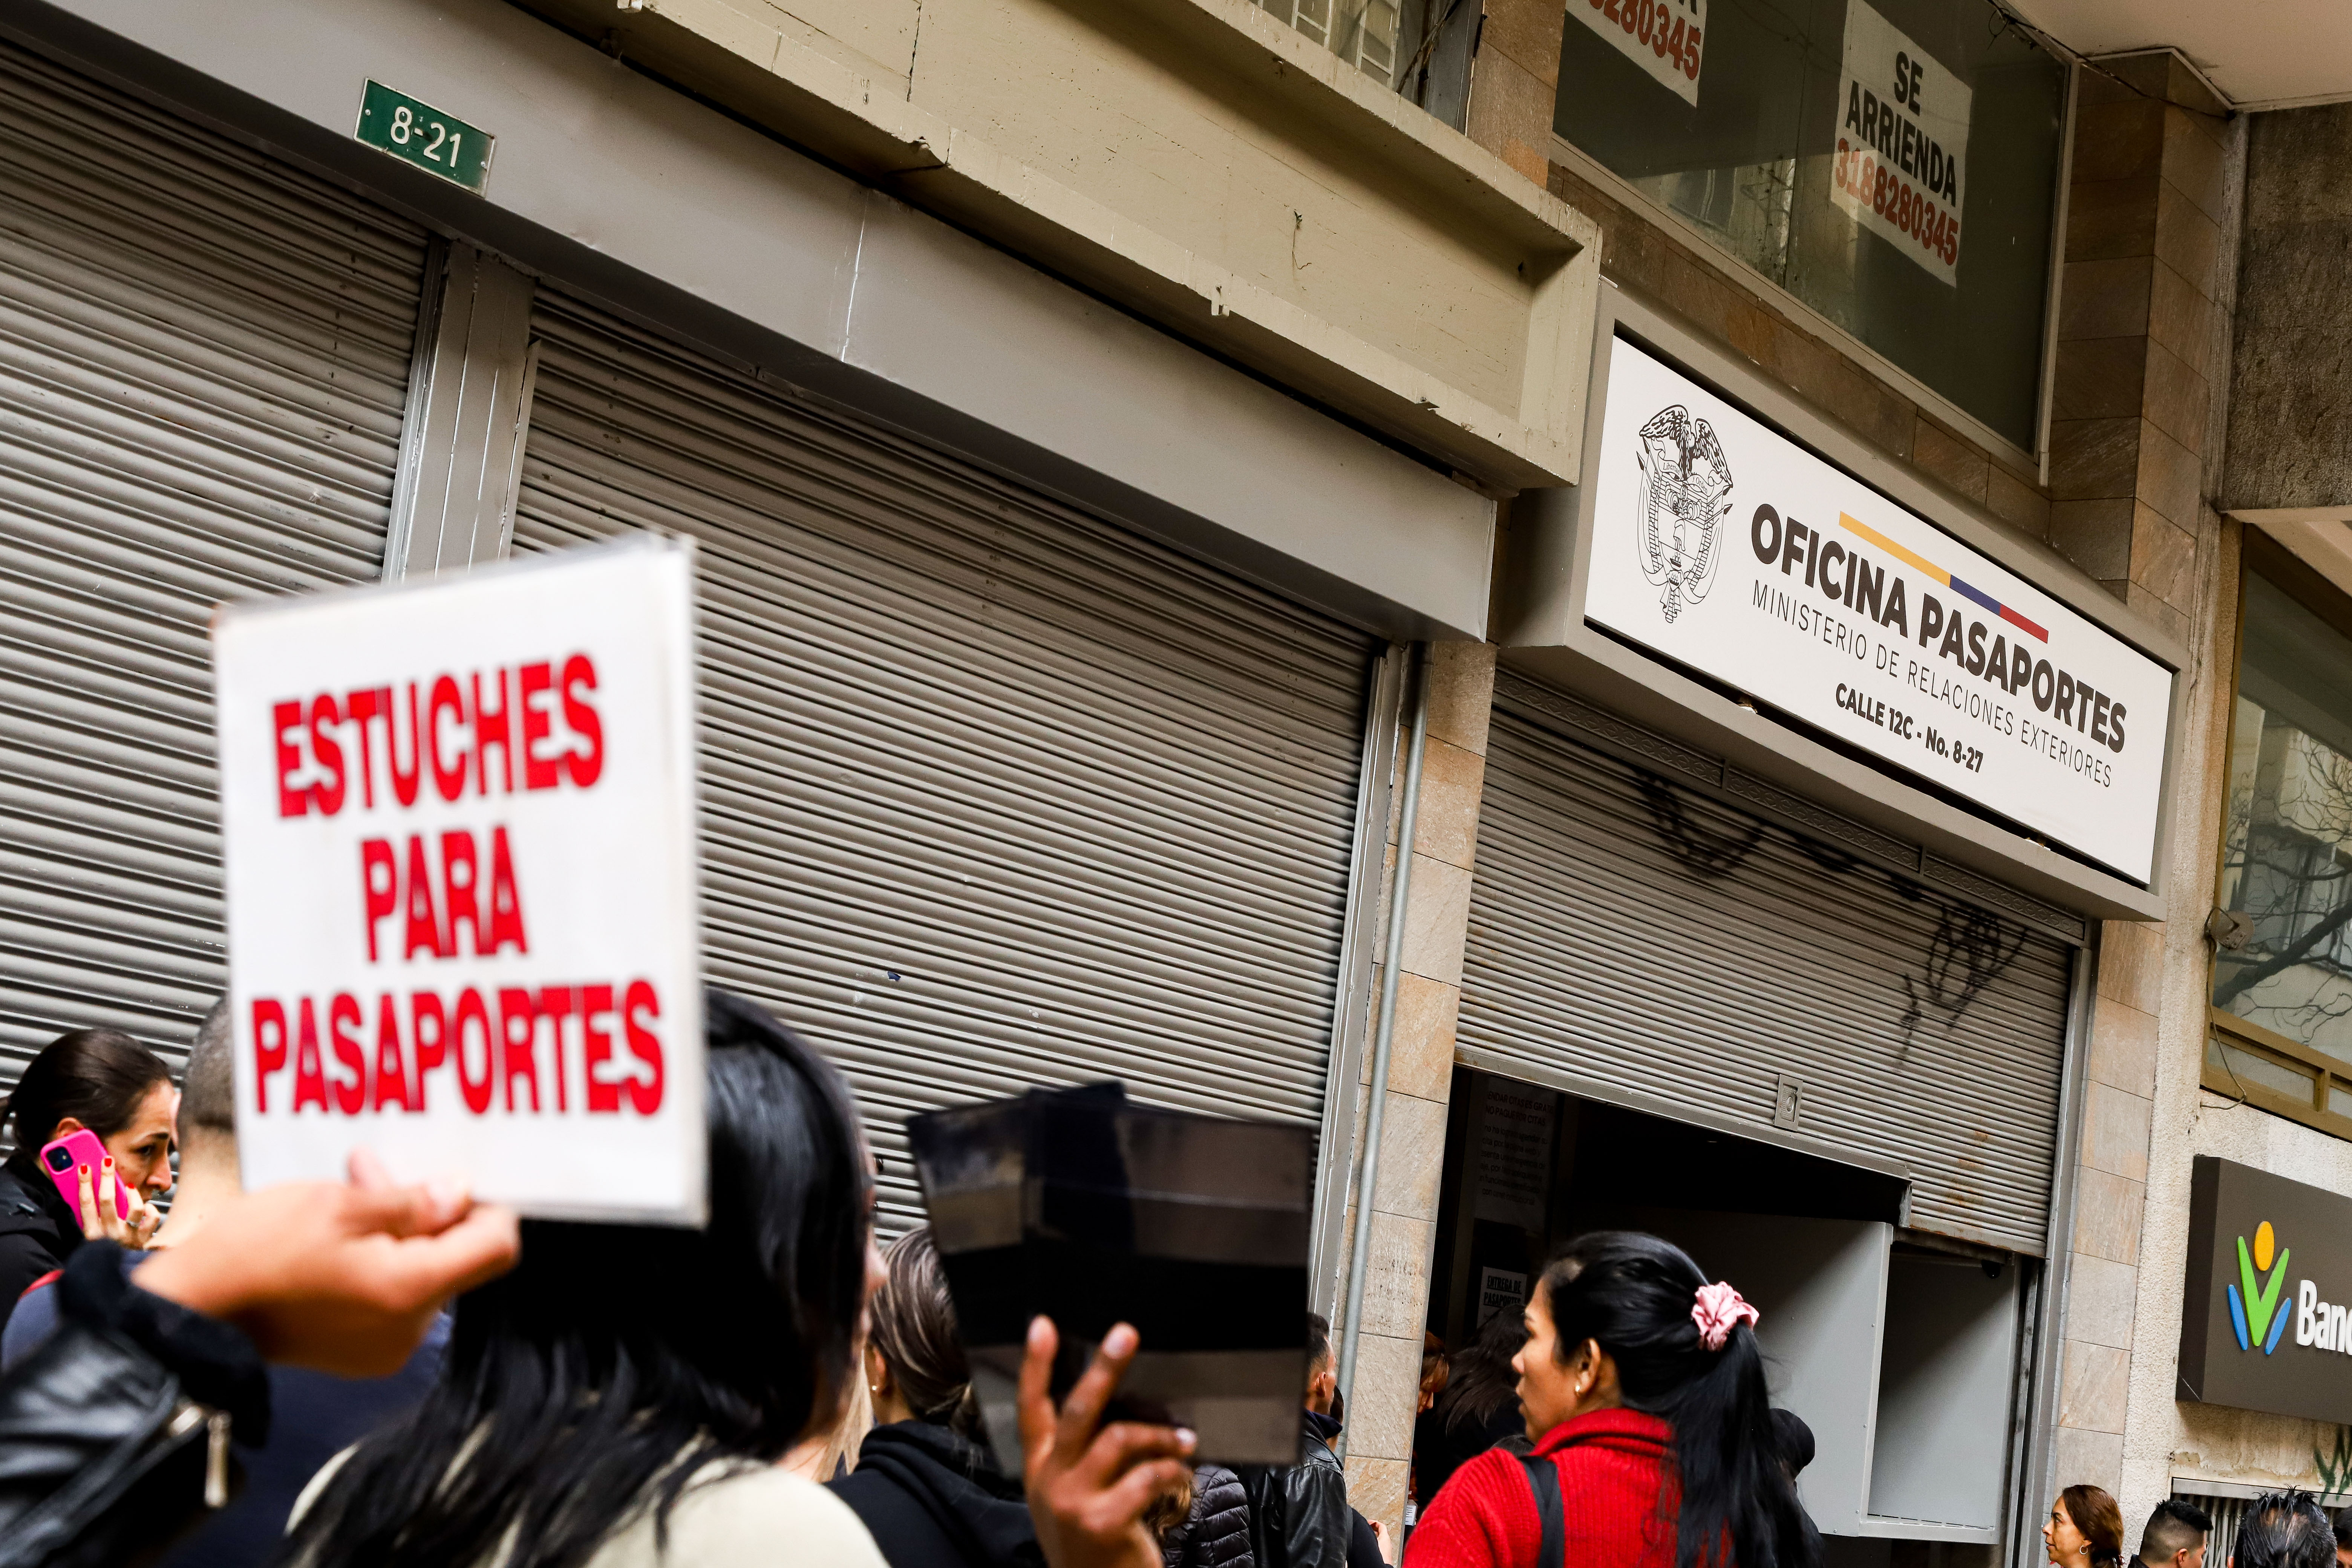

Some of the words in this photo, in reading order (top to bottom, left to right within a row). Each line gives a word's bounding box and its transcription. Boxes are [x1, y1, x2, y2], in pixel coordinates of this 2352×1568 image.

[1589, 0, 1701, 80] 80345
[1894, 51, 1923, 116] SE
[390, 106, 461, 168] 8-21
[1846, 80, 1956, 207] ARRIENDA
[1836, 138, 1958, 265] 3188280345
[1663, 462, 1680, 475] Libertad
[1696, 477, 1708, 494] Orden
[1751, 504, 1908, 639] OFICINA
[1919, 593, 2127, 753] PASAPORTES
[273, 654, 605, 818] ESTUCHES
[1753, 579, 1867, 660] MINISTERIO
[1876, 643, 1899, 678] DE
[1908, 660, 2013, 736] RELACIONES
[2021, 719, 2111, 787] EXTERIORES
[1836, 683, 1885, 727] CALLE
[1889, 707, 1914, 740] 12C
[1925, 726, 1949, 758] No.
[1953, 740, 1983, 773] 8-27
[361, 826, 528, 962] PARA
[251, 980, 665, 1117] PASAPORTES
[1487, 1091, 1508, 1103] ENDAR
[1487, 1275, 1513, 1290] ENTREGA
[1514, 1280, 1522, 1292] DE
